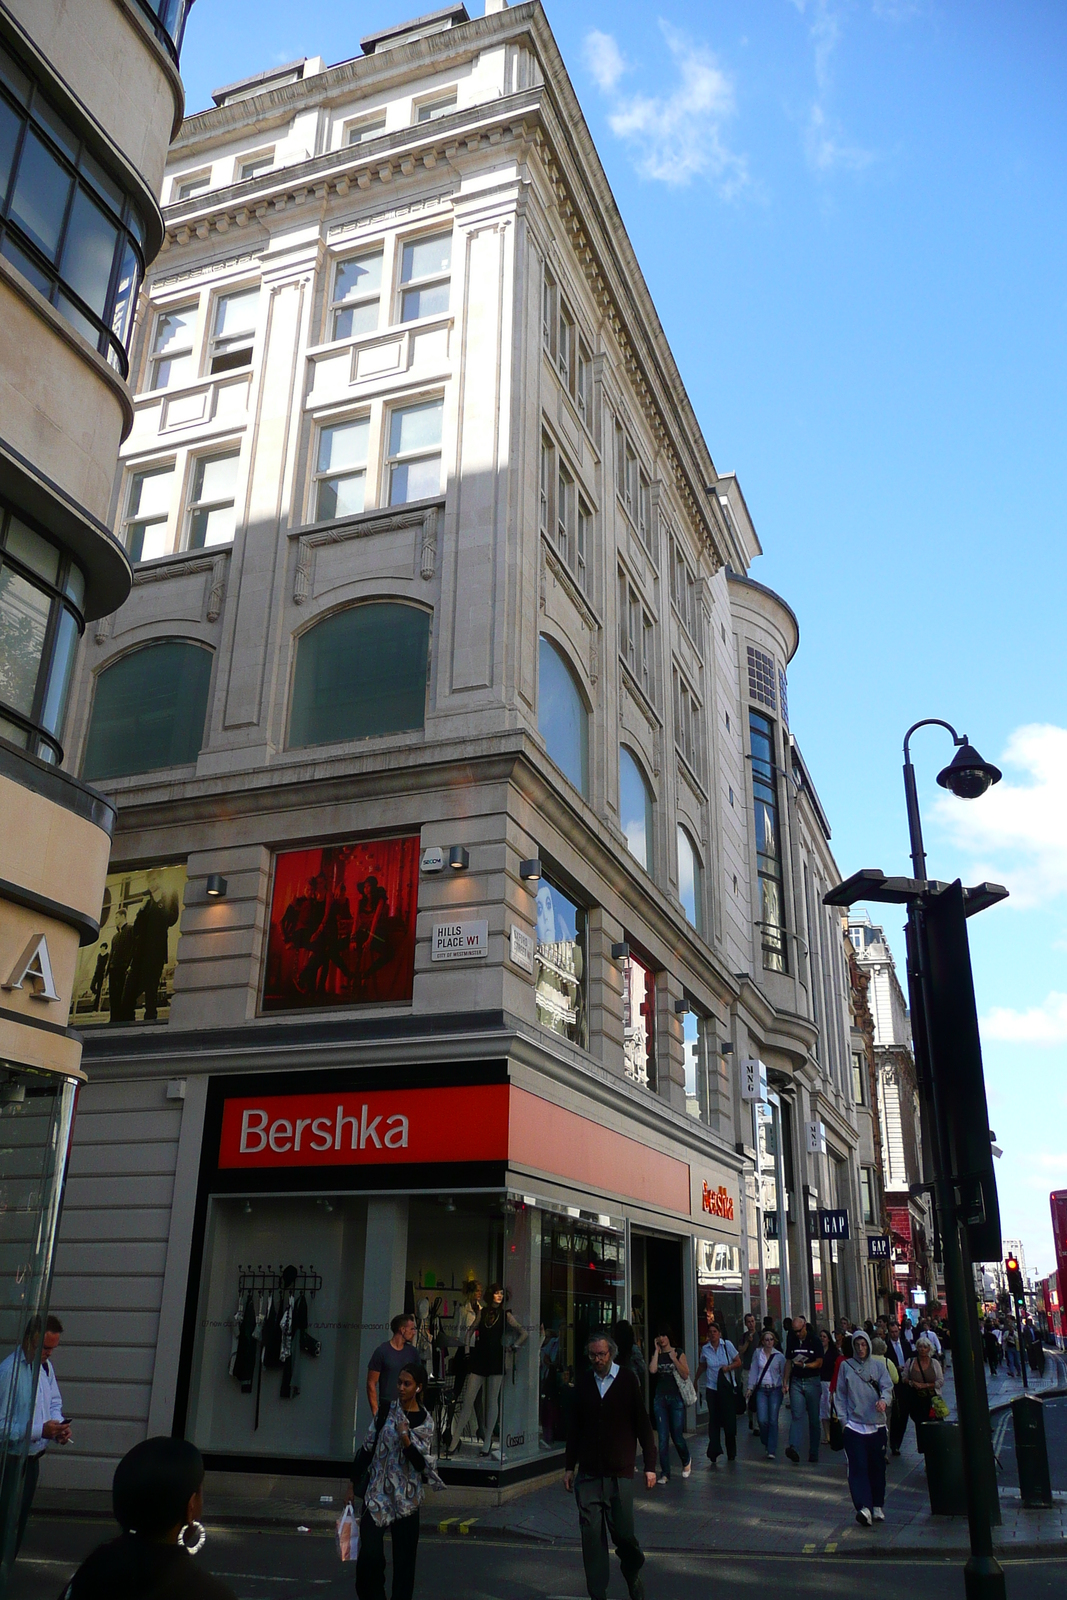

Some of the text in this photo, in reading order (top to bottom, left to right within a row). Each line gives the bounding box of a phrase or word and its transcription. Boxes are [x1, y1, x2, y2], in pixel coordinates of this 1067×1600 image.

[437, 925, 462, 938] HILLS
[437, 935, 479, 949] PLACE W1
[453, 949, 482, 957] WESTMINSTER
[1, 933, 61, 1002] A
[746, 1065, 754, 1092] MNG
[239, 1104, 409, 1154] Bershka
[824, 1216, 845, 1233] GAP
[872, 1240, 886, 1252] GAP
